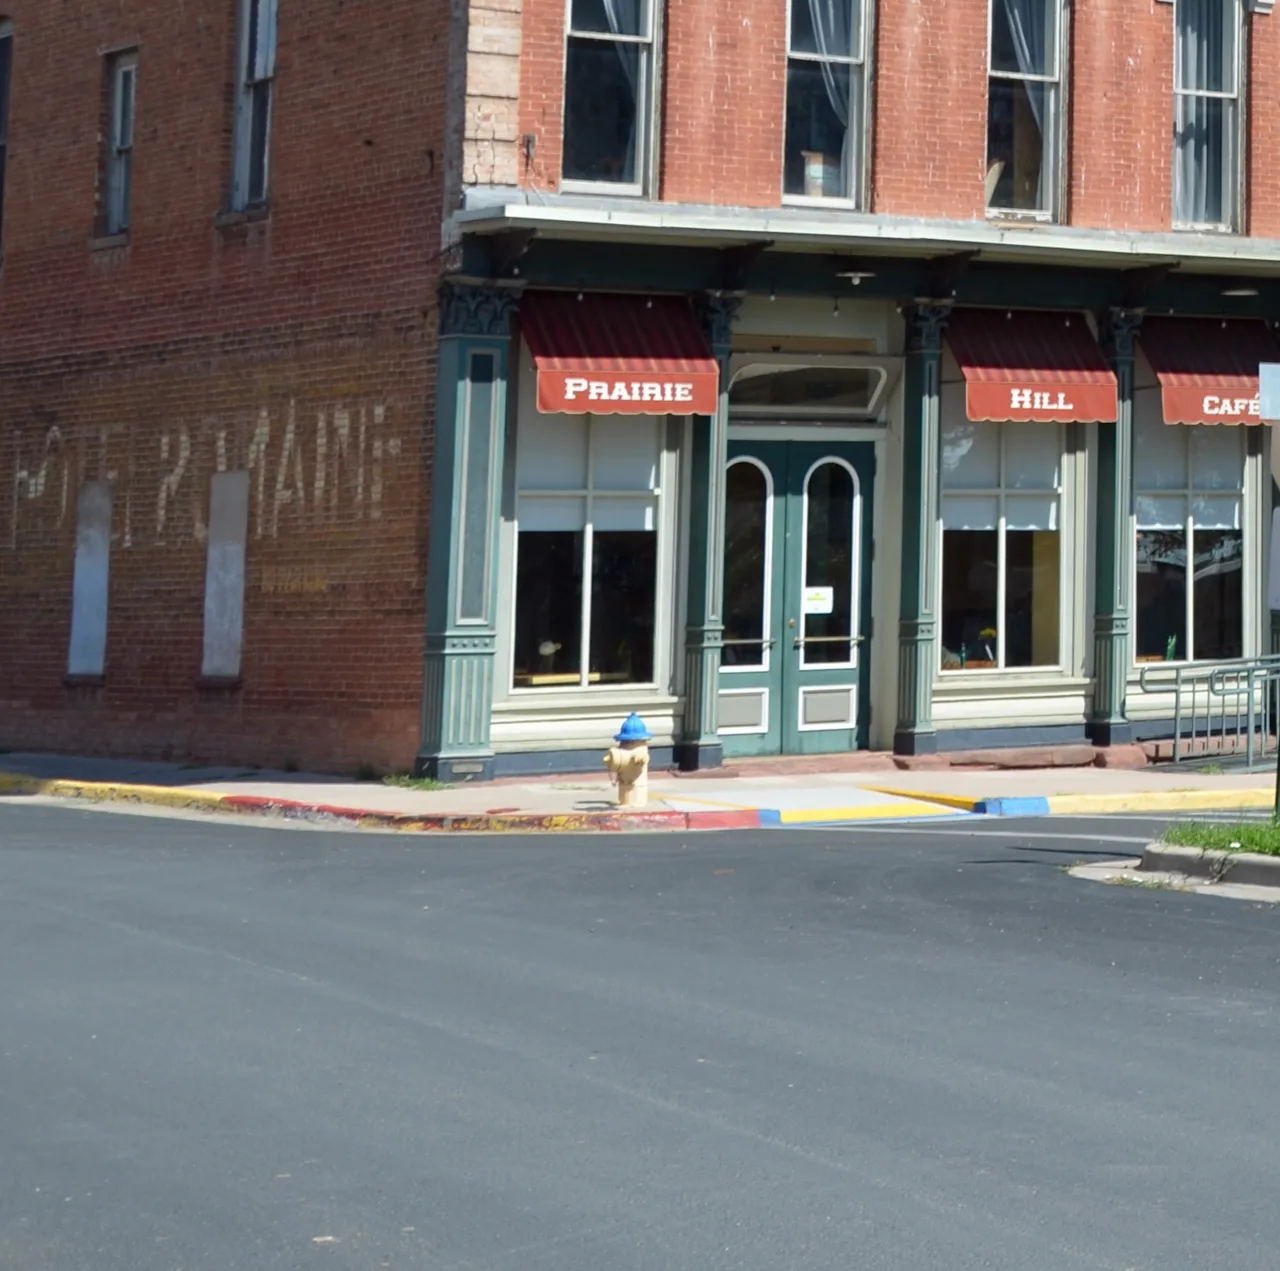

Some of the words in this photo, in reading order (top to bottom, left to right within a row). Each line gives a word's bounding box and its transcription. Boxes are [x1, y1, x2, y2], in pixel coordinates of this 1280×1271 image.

[564, 377, 693, 401] PRAIRIE
[1010, 388, 1074, 410] HILL
[1202, 393, 1261, 416] CAFÉ
